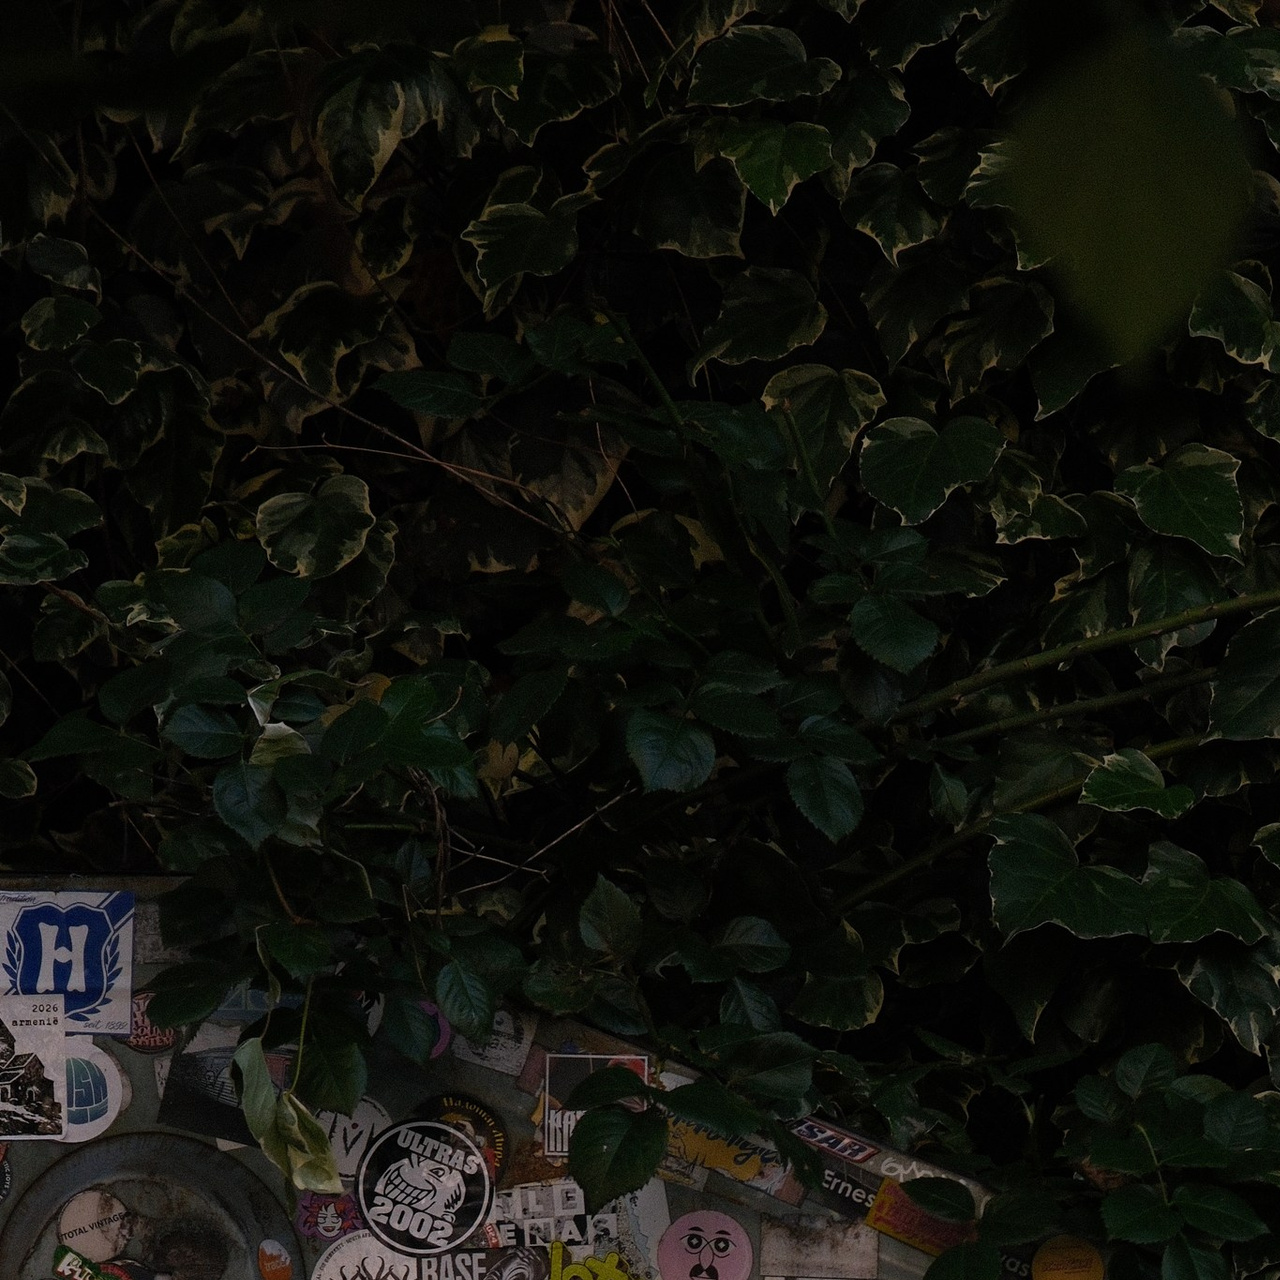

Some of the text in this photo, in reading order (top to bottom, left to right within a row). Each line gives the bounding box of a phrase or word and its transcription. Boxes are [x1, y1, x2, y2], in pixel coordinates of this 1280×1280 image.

[397, 1129, 480, 1174] ULTRAS
[61, 1212, 125, 1241] TOTAL VINTAGE
[369, 1195, 454, 1247] 2002
